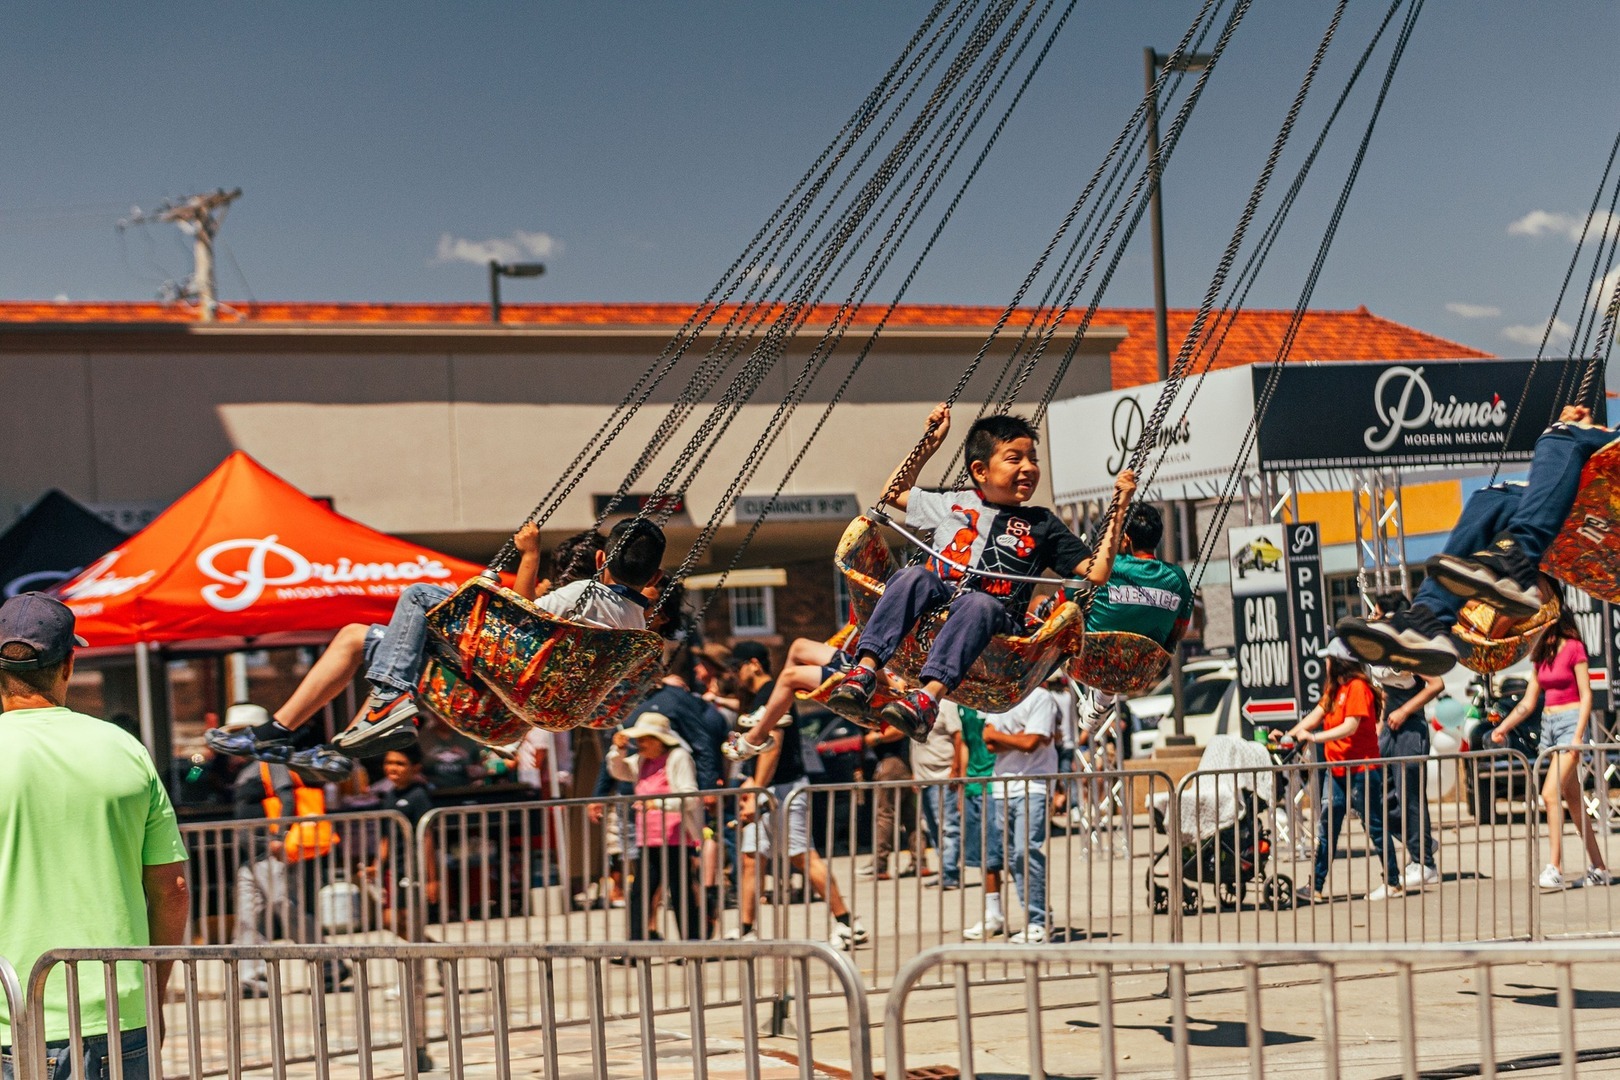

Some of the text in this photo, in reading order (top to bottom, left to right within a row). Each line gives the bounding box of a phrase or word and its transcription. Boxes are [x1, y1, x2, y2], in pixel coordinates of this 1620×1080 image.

[1364, 366, 1507, 451] Primo's
[1404, 431, 1503, 445] MODERN MEXICAN
[196, 534, 451, 612] Primo's
[1244, 596, 1279, 642] CAR
[1240, 641, 1290, 688] SHOW
